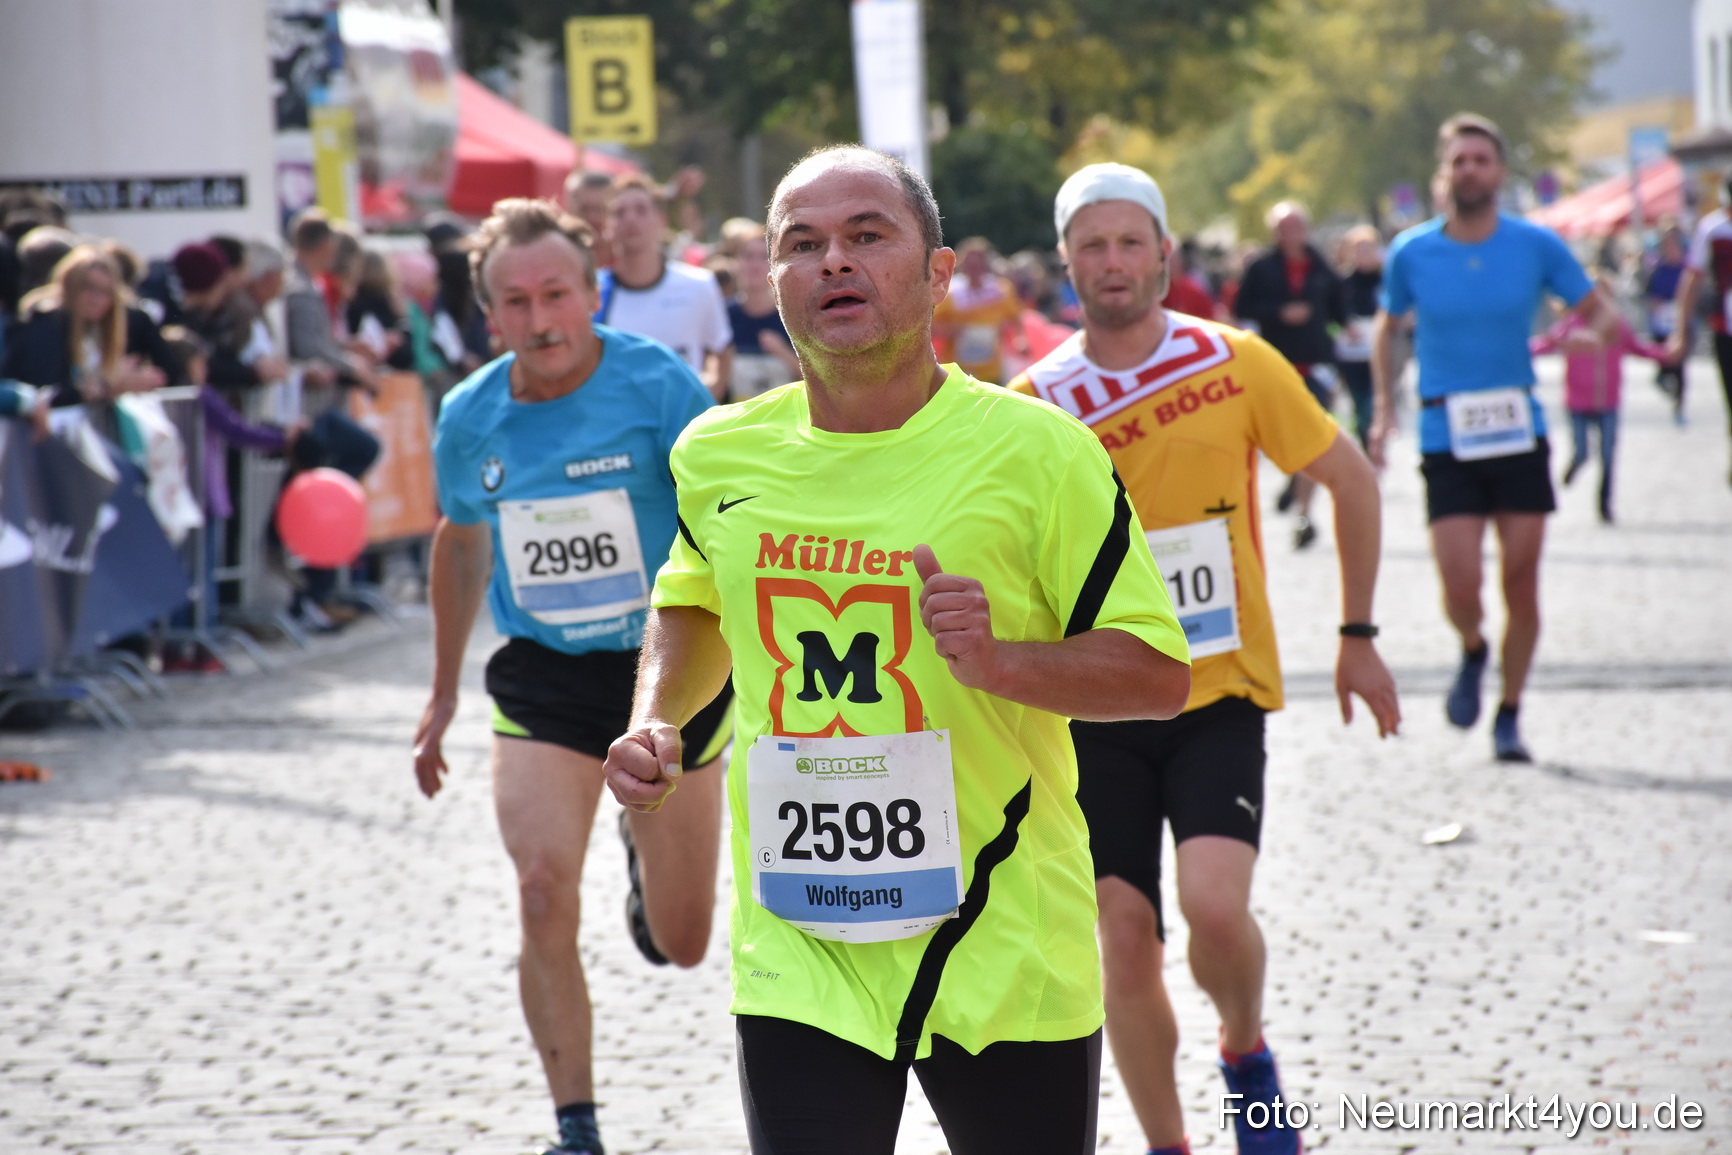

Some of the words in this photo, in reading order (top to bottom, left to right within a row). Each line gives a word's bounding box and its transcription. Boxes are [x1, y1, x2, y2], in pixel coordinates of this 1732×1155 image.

[592, 57, 632, 116] B
[1100, 416, 1147, 451] AX
[1154, 374, 1245, 427] BÖGL
[565, 453, 631, 478] BOCK
[523, 532, 619, 576] 2996
[755, 532, 914, 577] Müller
[1166, 565, 1214, 608] 10
[796, 630, 883, 704] M
[814, 756, 888, 774] BOCK
[778, 798, 926, 863] 2598
[763, 851, 771, 863] C
[805, 884, 903, 912] Wolfgang
[750, 969, 781, 981] DRI-FIT
